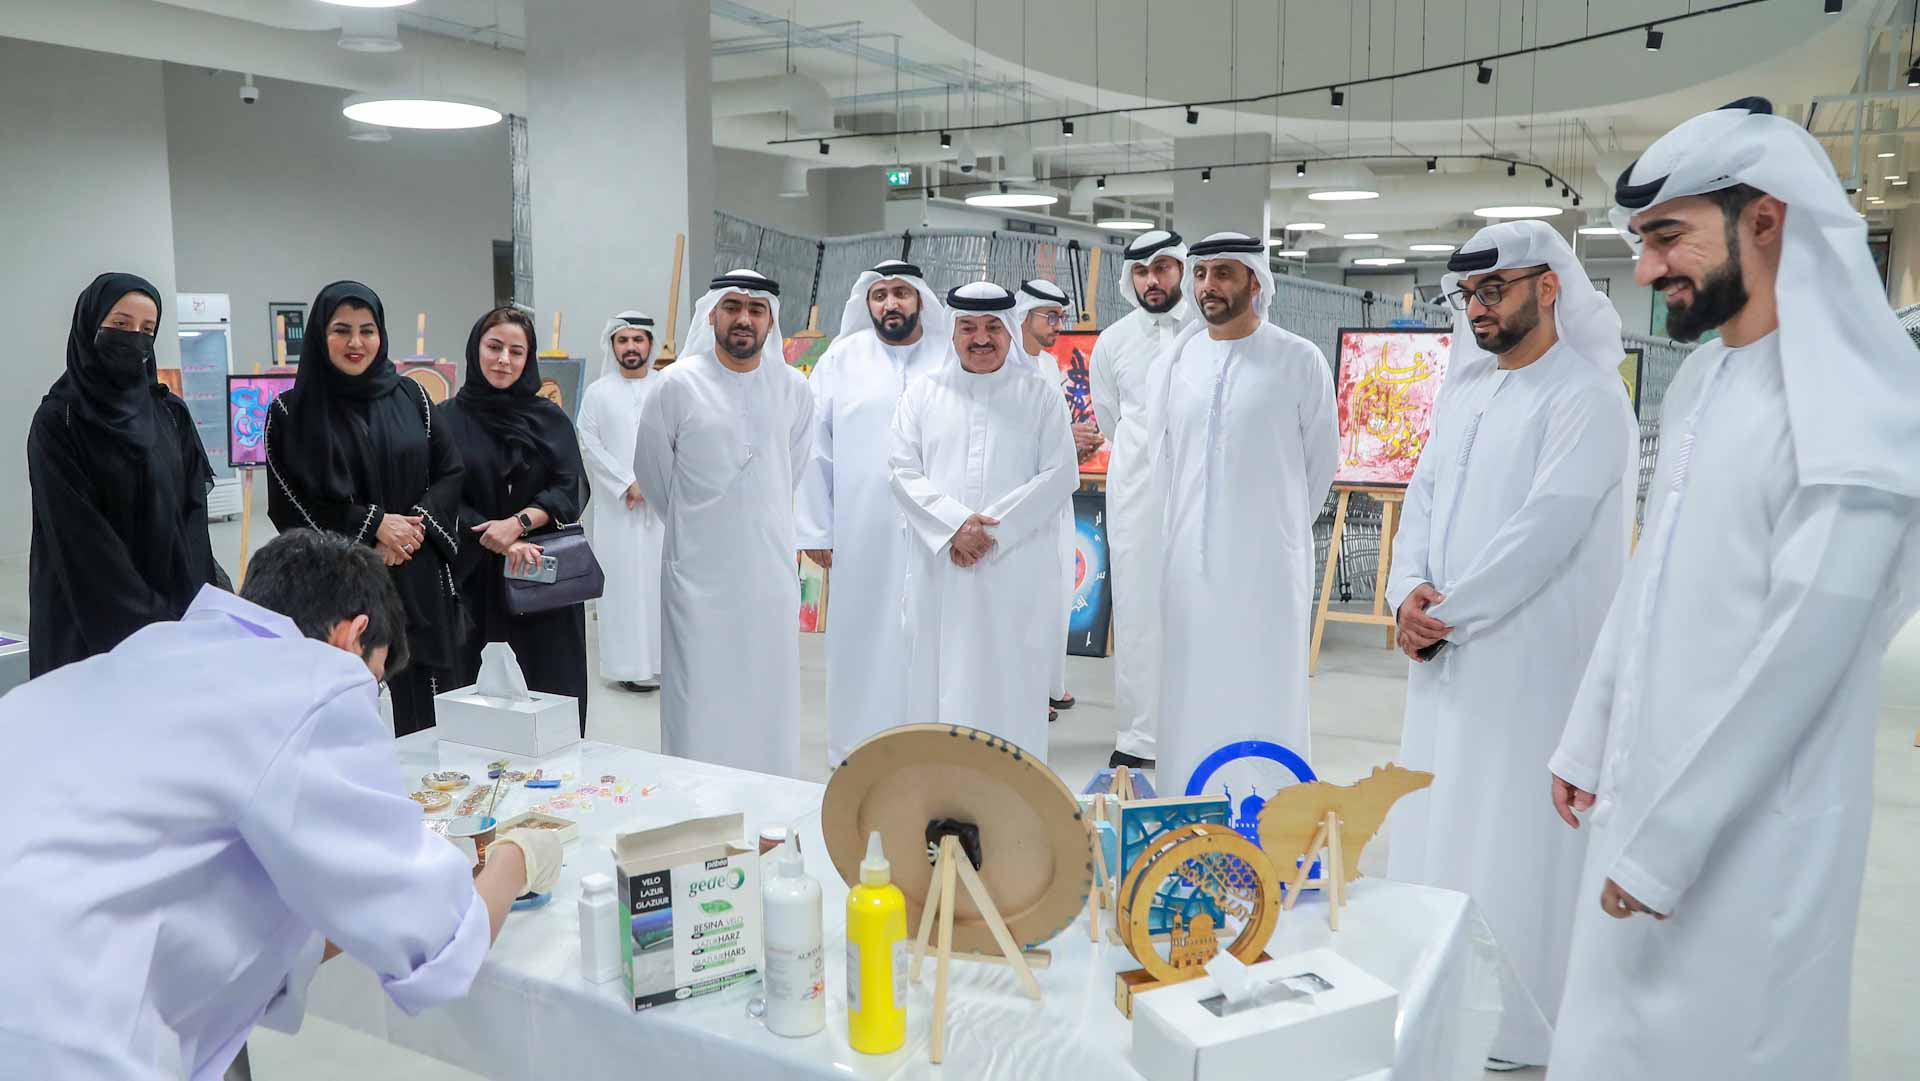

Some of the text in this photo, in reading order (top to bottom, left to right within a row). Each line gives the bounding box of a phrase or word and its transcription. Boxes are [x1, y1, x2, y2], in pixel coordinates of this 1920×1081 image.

[641, 876, 661, 886] VELO
[640, 887, 664, 899] LAZUR
[635, 896, 670, 910] GLAZUUR
[693, 920, 724, 933] RESINA
